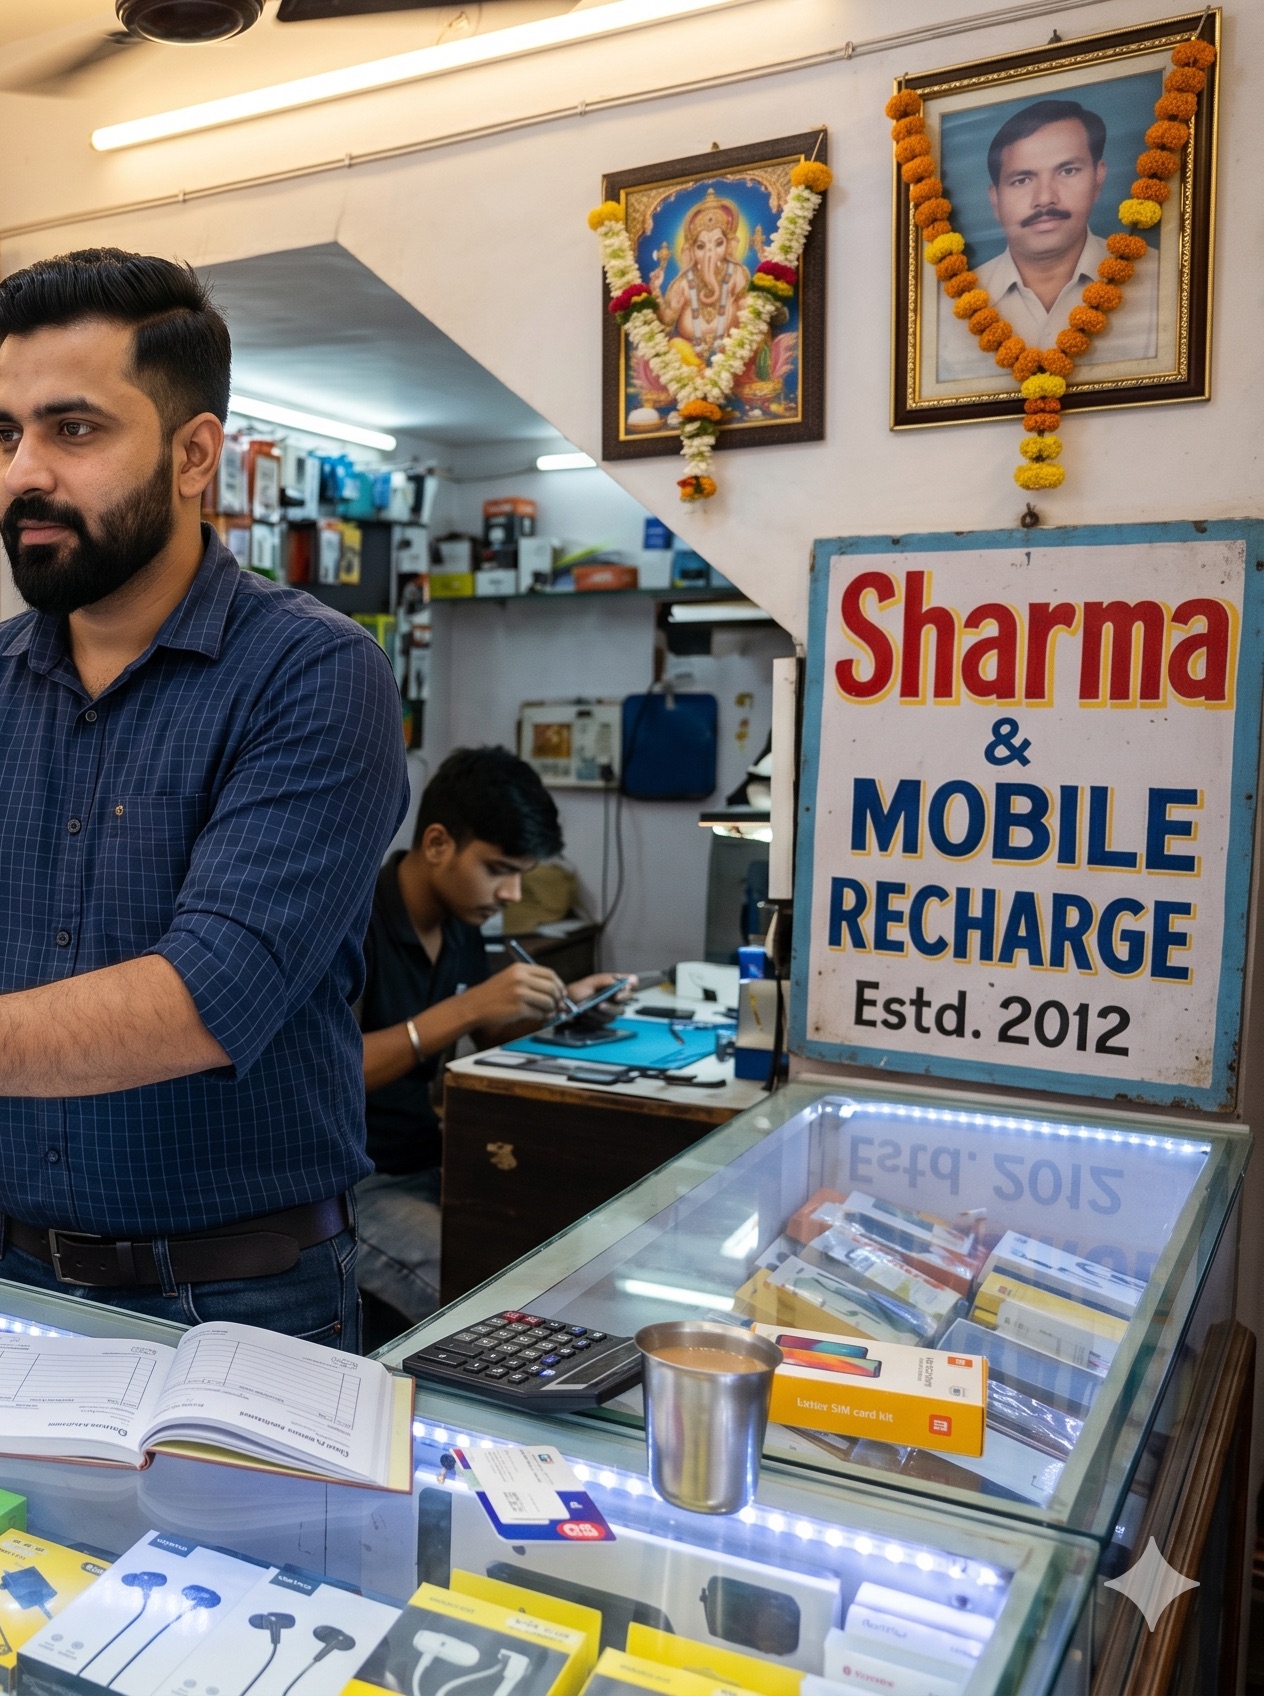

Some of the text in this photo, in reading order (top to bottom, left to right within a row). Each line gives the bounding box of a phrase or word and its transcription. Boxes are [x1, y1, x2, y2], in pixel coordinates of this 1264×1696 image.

[835, 569, 1240, 711] Sharma
[983, 716, 1032, 767] &
[850, 777, 1205, 878] MOBILE
[828, 876, 1198, 986] RECHARGE
[853, 979, 1132, 1057] Estd. 2012
[831, 1403, 851, 1416] SIM
[853, 1408, 877, 1421] card
[879, 1412, 894, 1423] kit
